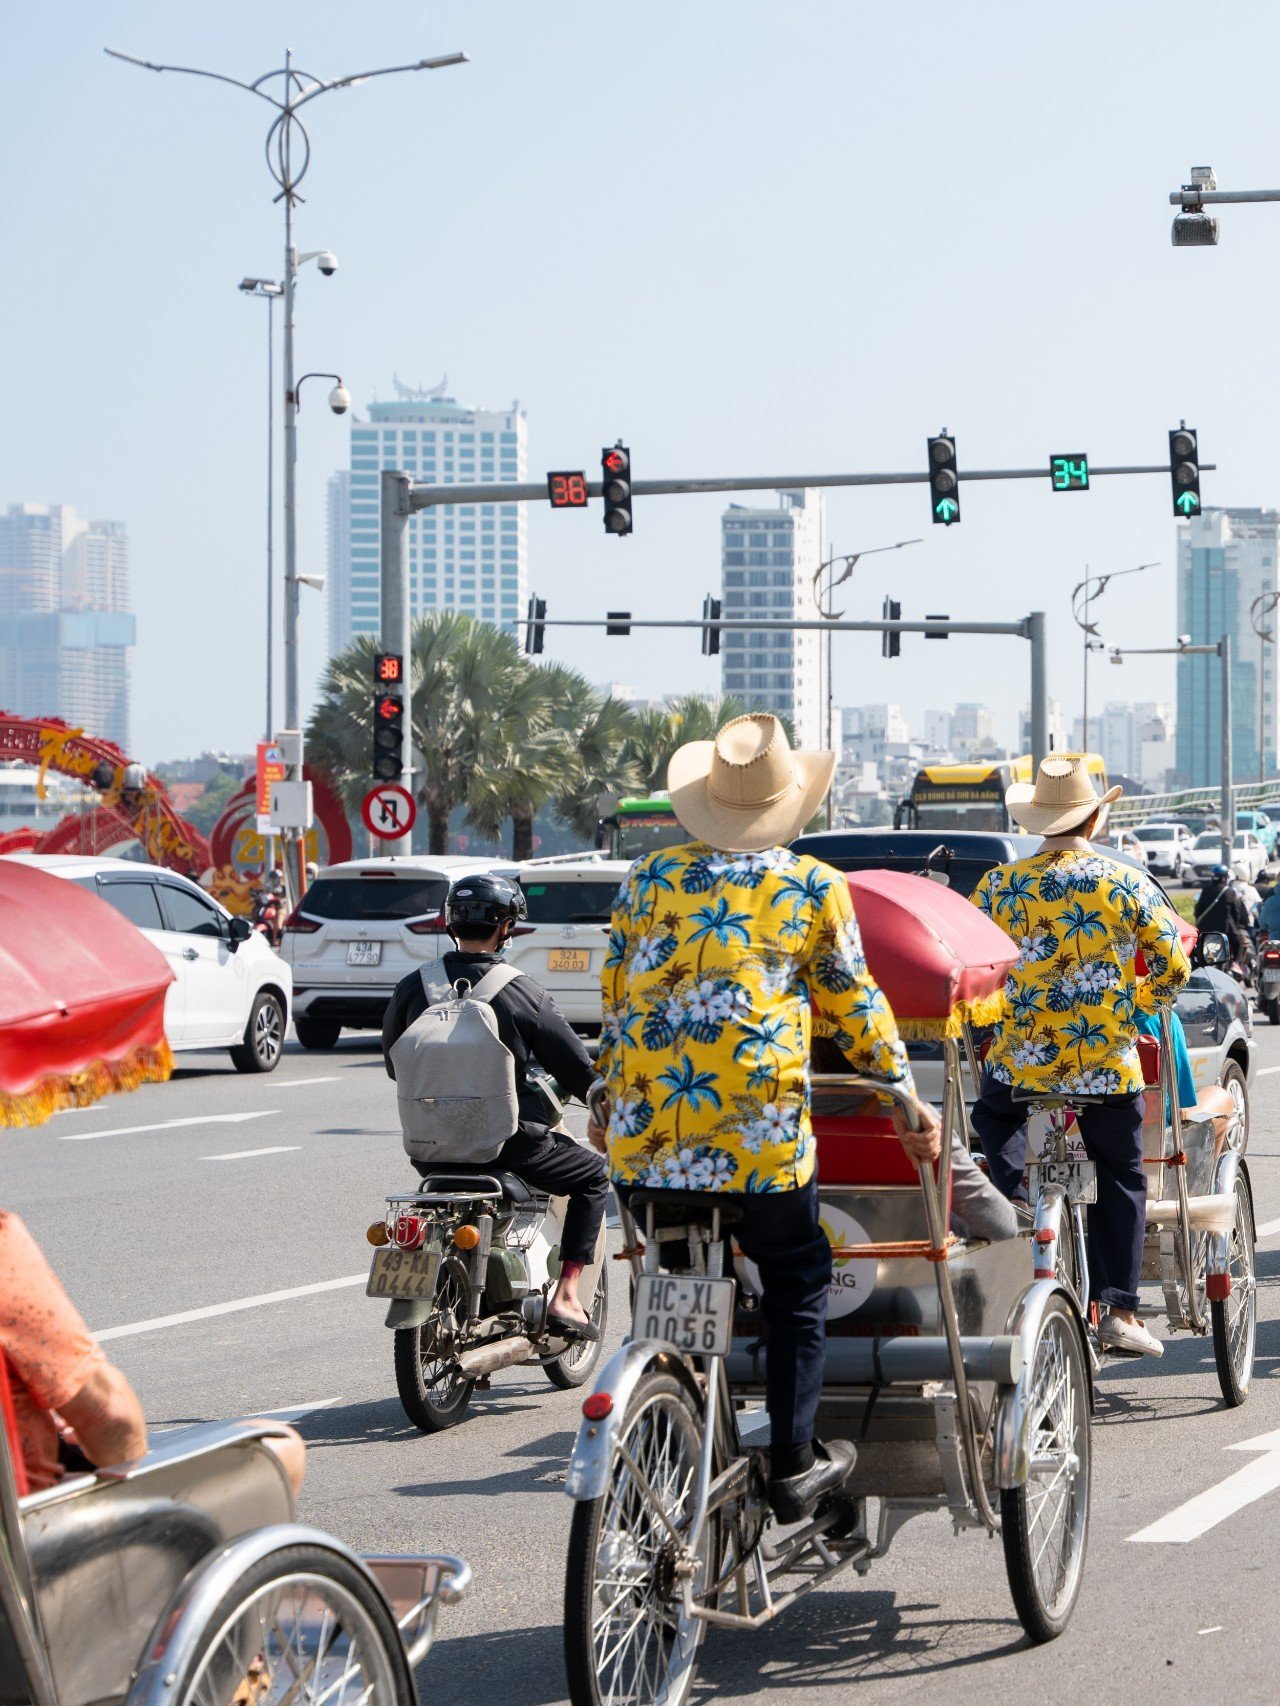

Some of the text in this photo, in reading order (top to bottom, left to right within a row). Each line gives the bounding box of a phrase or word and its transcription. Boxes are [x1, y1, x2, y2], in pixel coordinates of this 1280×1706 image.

[1054, 460, 1087, 488] 34
[552, 475, 586, 506] 38
[380, 659, 398, 678] 38
[356, 941, 372, 952] 43A
[560, 950, 578, 960] 92A
[382, 1252, 430, 1275] 43-KA
[376, 1273, 426, 1297] 0444
[648, 1280, 717, 1315] HC-XL
[645, 1314, 716, 1350] 0056
